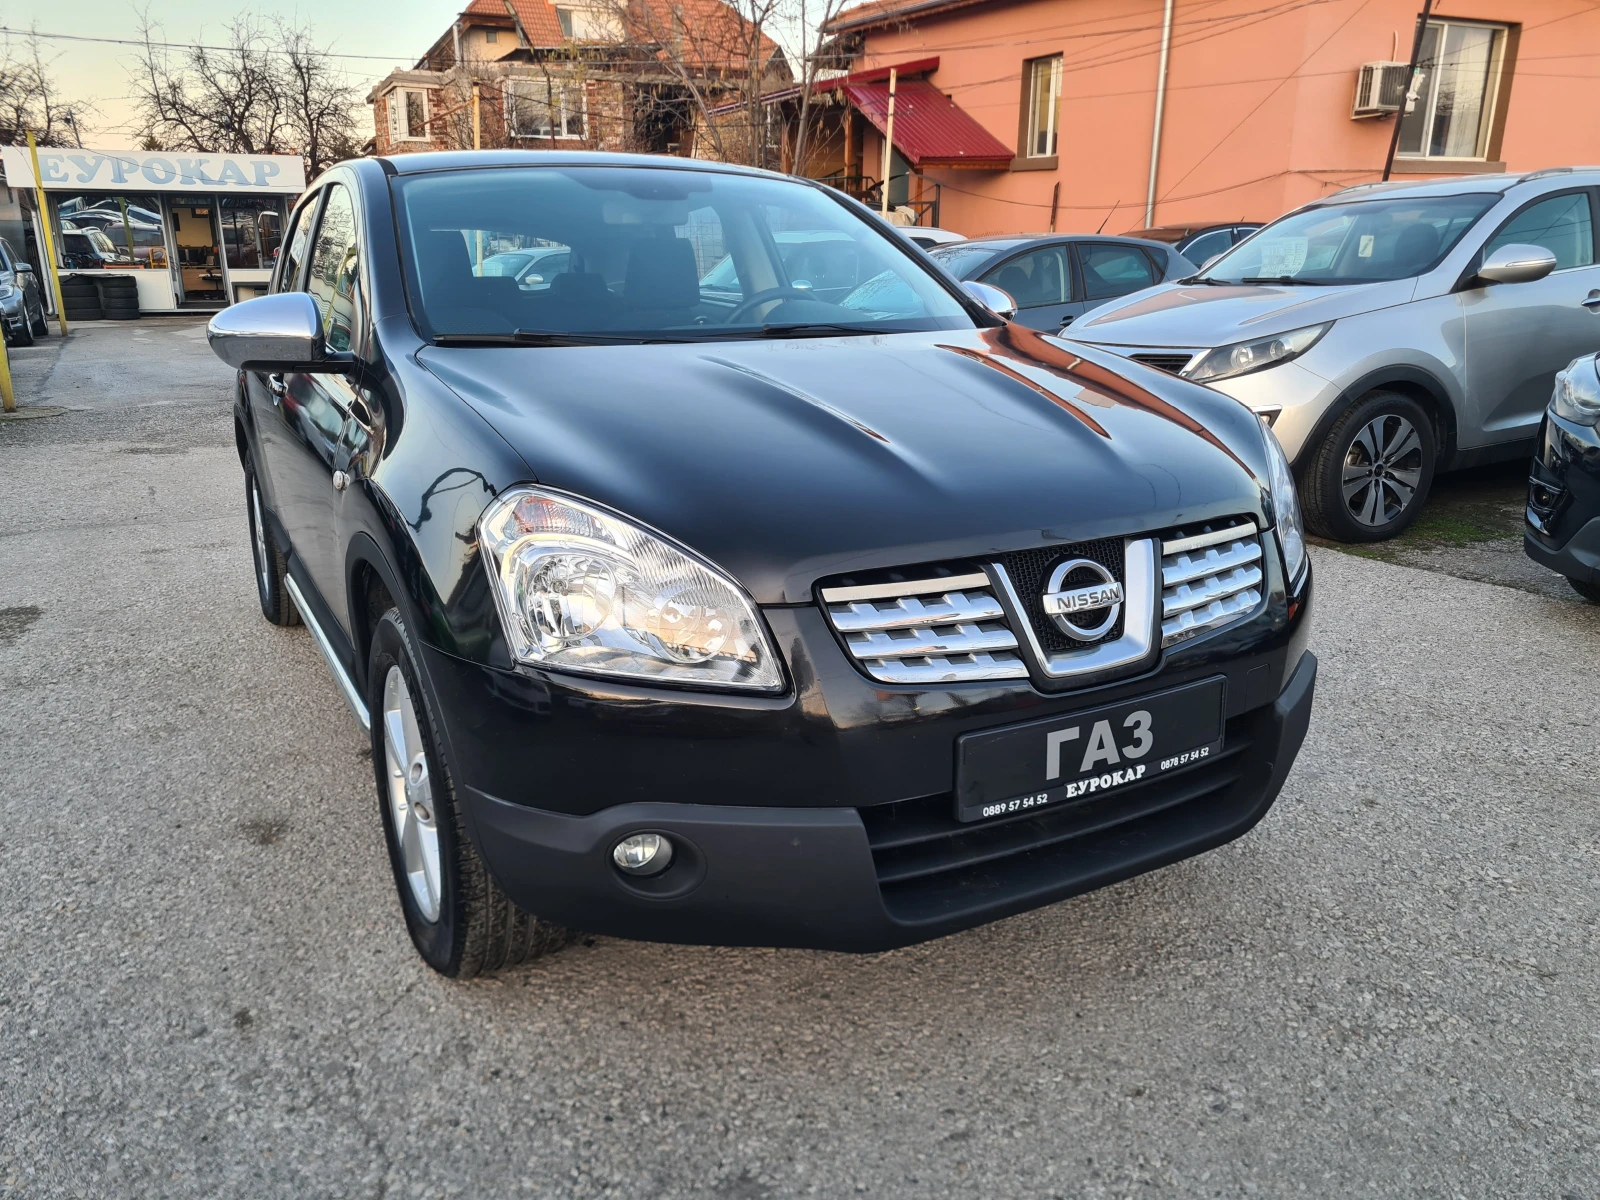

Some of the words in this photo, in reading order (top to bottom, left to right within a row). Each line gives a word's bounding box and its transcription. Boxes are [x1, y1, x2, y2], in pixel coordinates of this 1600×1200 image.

[36, 153, 280, 187] ЕУРОКАР
[1056, 586, 1120, 611] NISSAN
[1046, 710, 1154, 781] ГАЗ
[1160, 757, 1179, 770] 0878
[1180, 753, 1190, 764] 57
[1190, 750, 1199, 760] 54
[1200, 746, 1210, 757] 52
[1066, 764, 1146, 799] ЕУРОКАР
[982, 803, 1007, 817] 0889
[1008, 800, 1021, 811] 57
[1022, 796, 1034, 808] 54
[1036, 793, 1048, 804] 52
